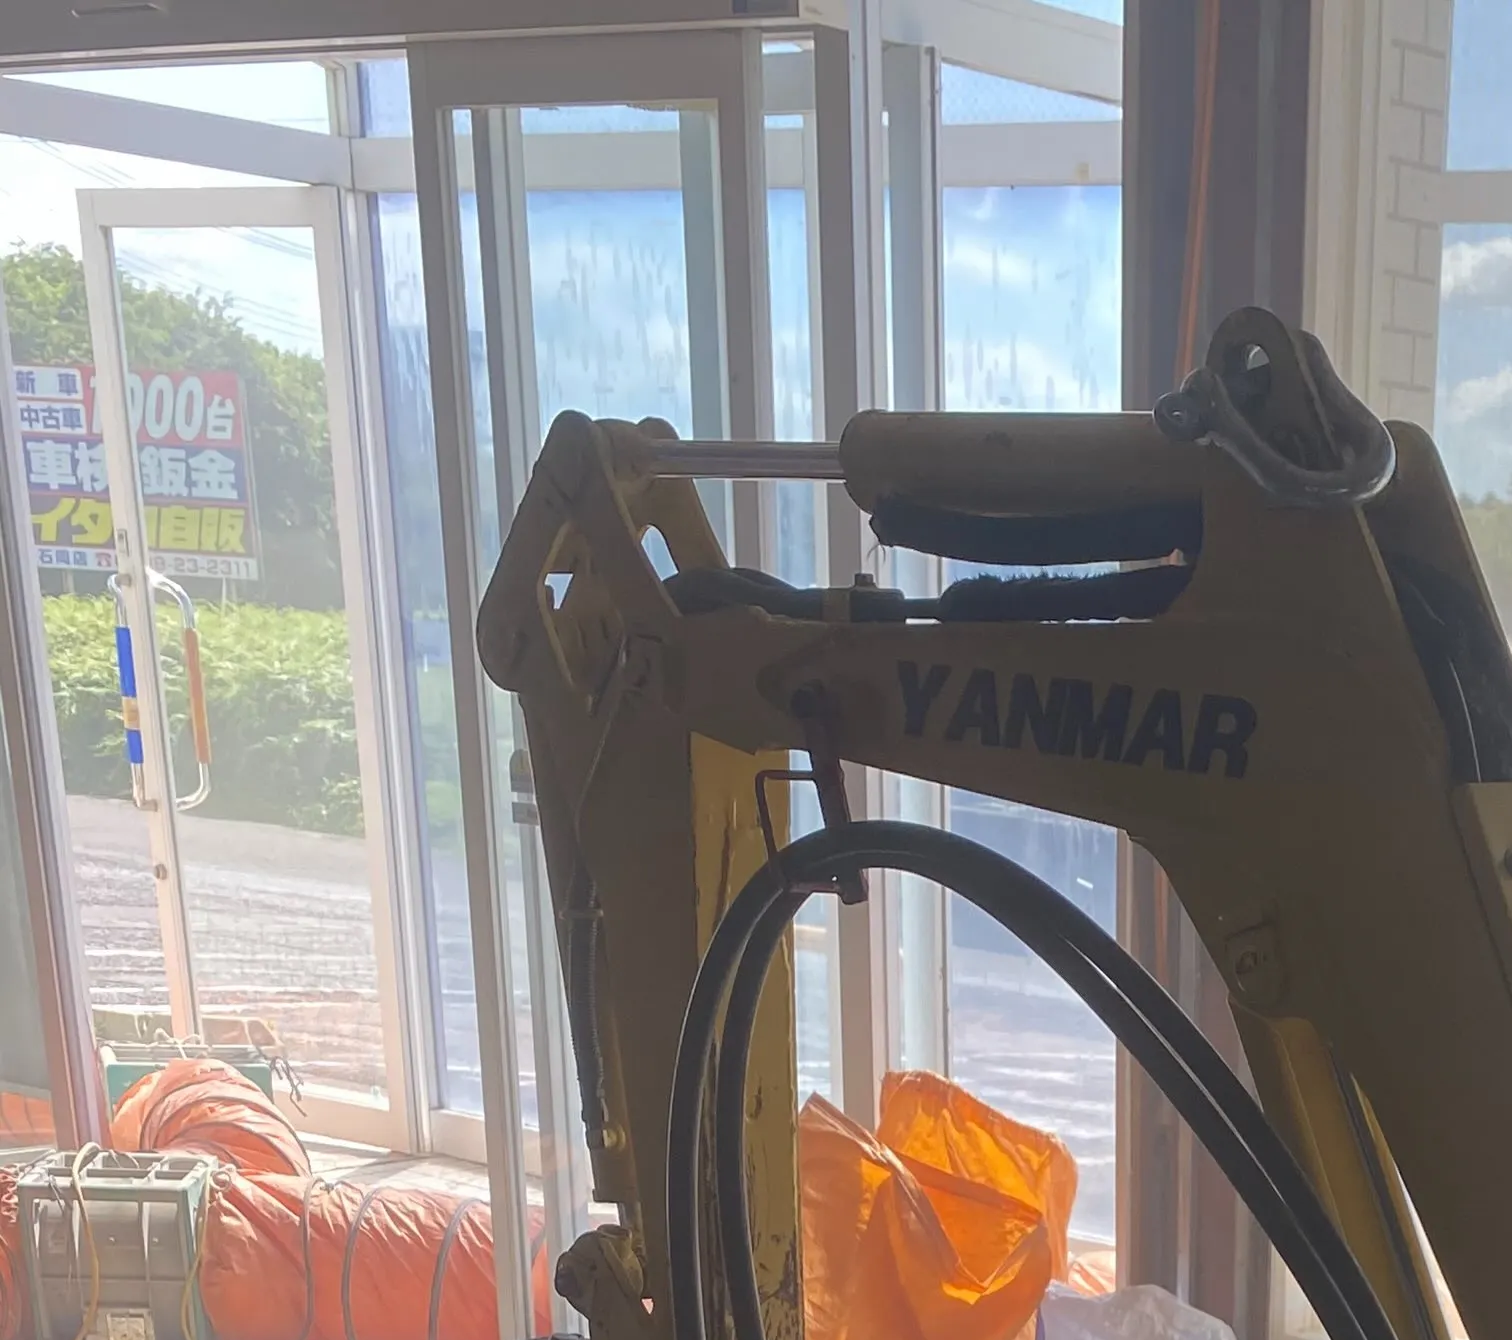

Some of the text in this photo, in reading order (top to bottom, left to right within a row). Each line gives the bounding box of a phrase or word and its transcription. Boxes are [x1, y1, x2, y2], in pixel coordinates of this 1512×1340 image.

[20, 405, 83, 430] 中古車
[896, 660, 1257, 779] YANMAR
